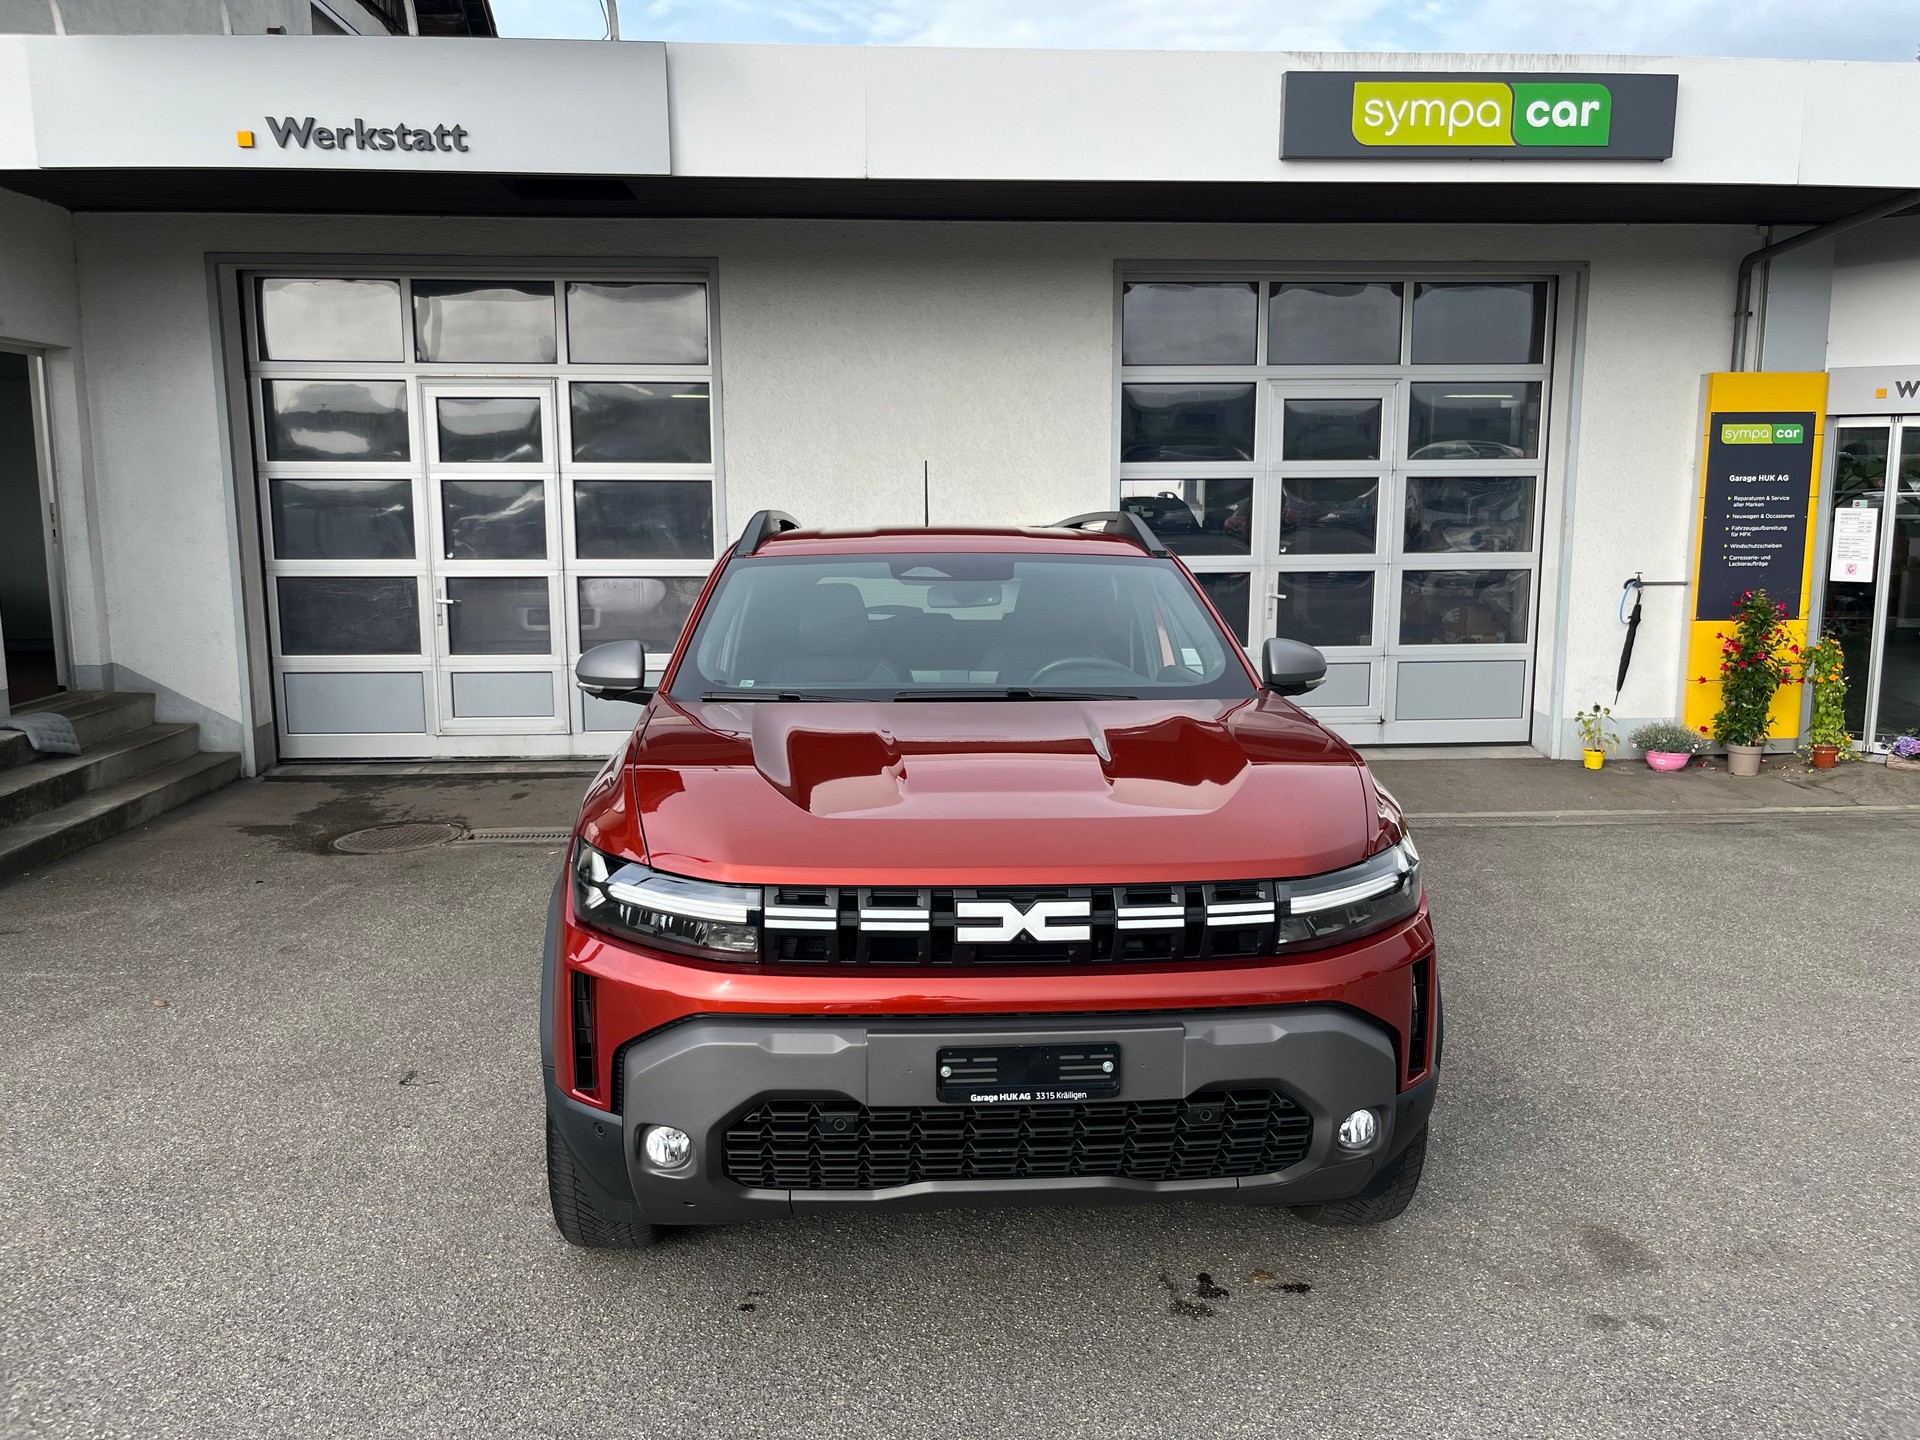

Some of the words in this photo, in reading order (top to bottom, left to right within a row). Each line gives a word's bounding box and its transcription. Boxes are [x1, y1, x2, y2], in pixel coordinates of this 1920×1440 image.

[1363, 97, 1502, 137] sympa
[1525, 99, 1601, 128] car
[264, 116, 470, 153] Werkstatt
[1725, 429, 1769, 441] sympa
[1776, 429, 1800, 438] car
[1729, 474, 1757, 483] Garage
[1758, 474, 1776, 482] HUK
[1777, 474, 1789, 482] AG
[970, 1093, 998, 1103] Garage
[999, 1093, 1019, 1101] HUK
[1019, 1092, 1031, 1101] AG
[1036, 1092, 1055, 1100] 3315
[1056, 1090, 1087, 1101] Kräiligen
